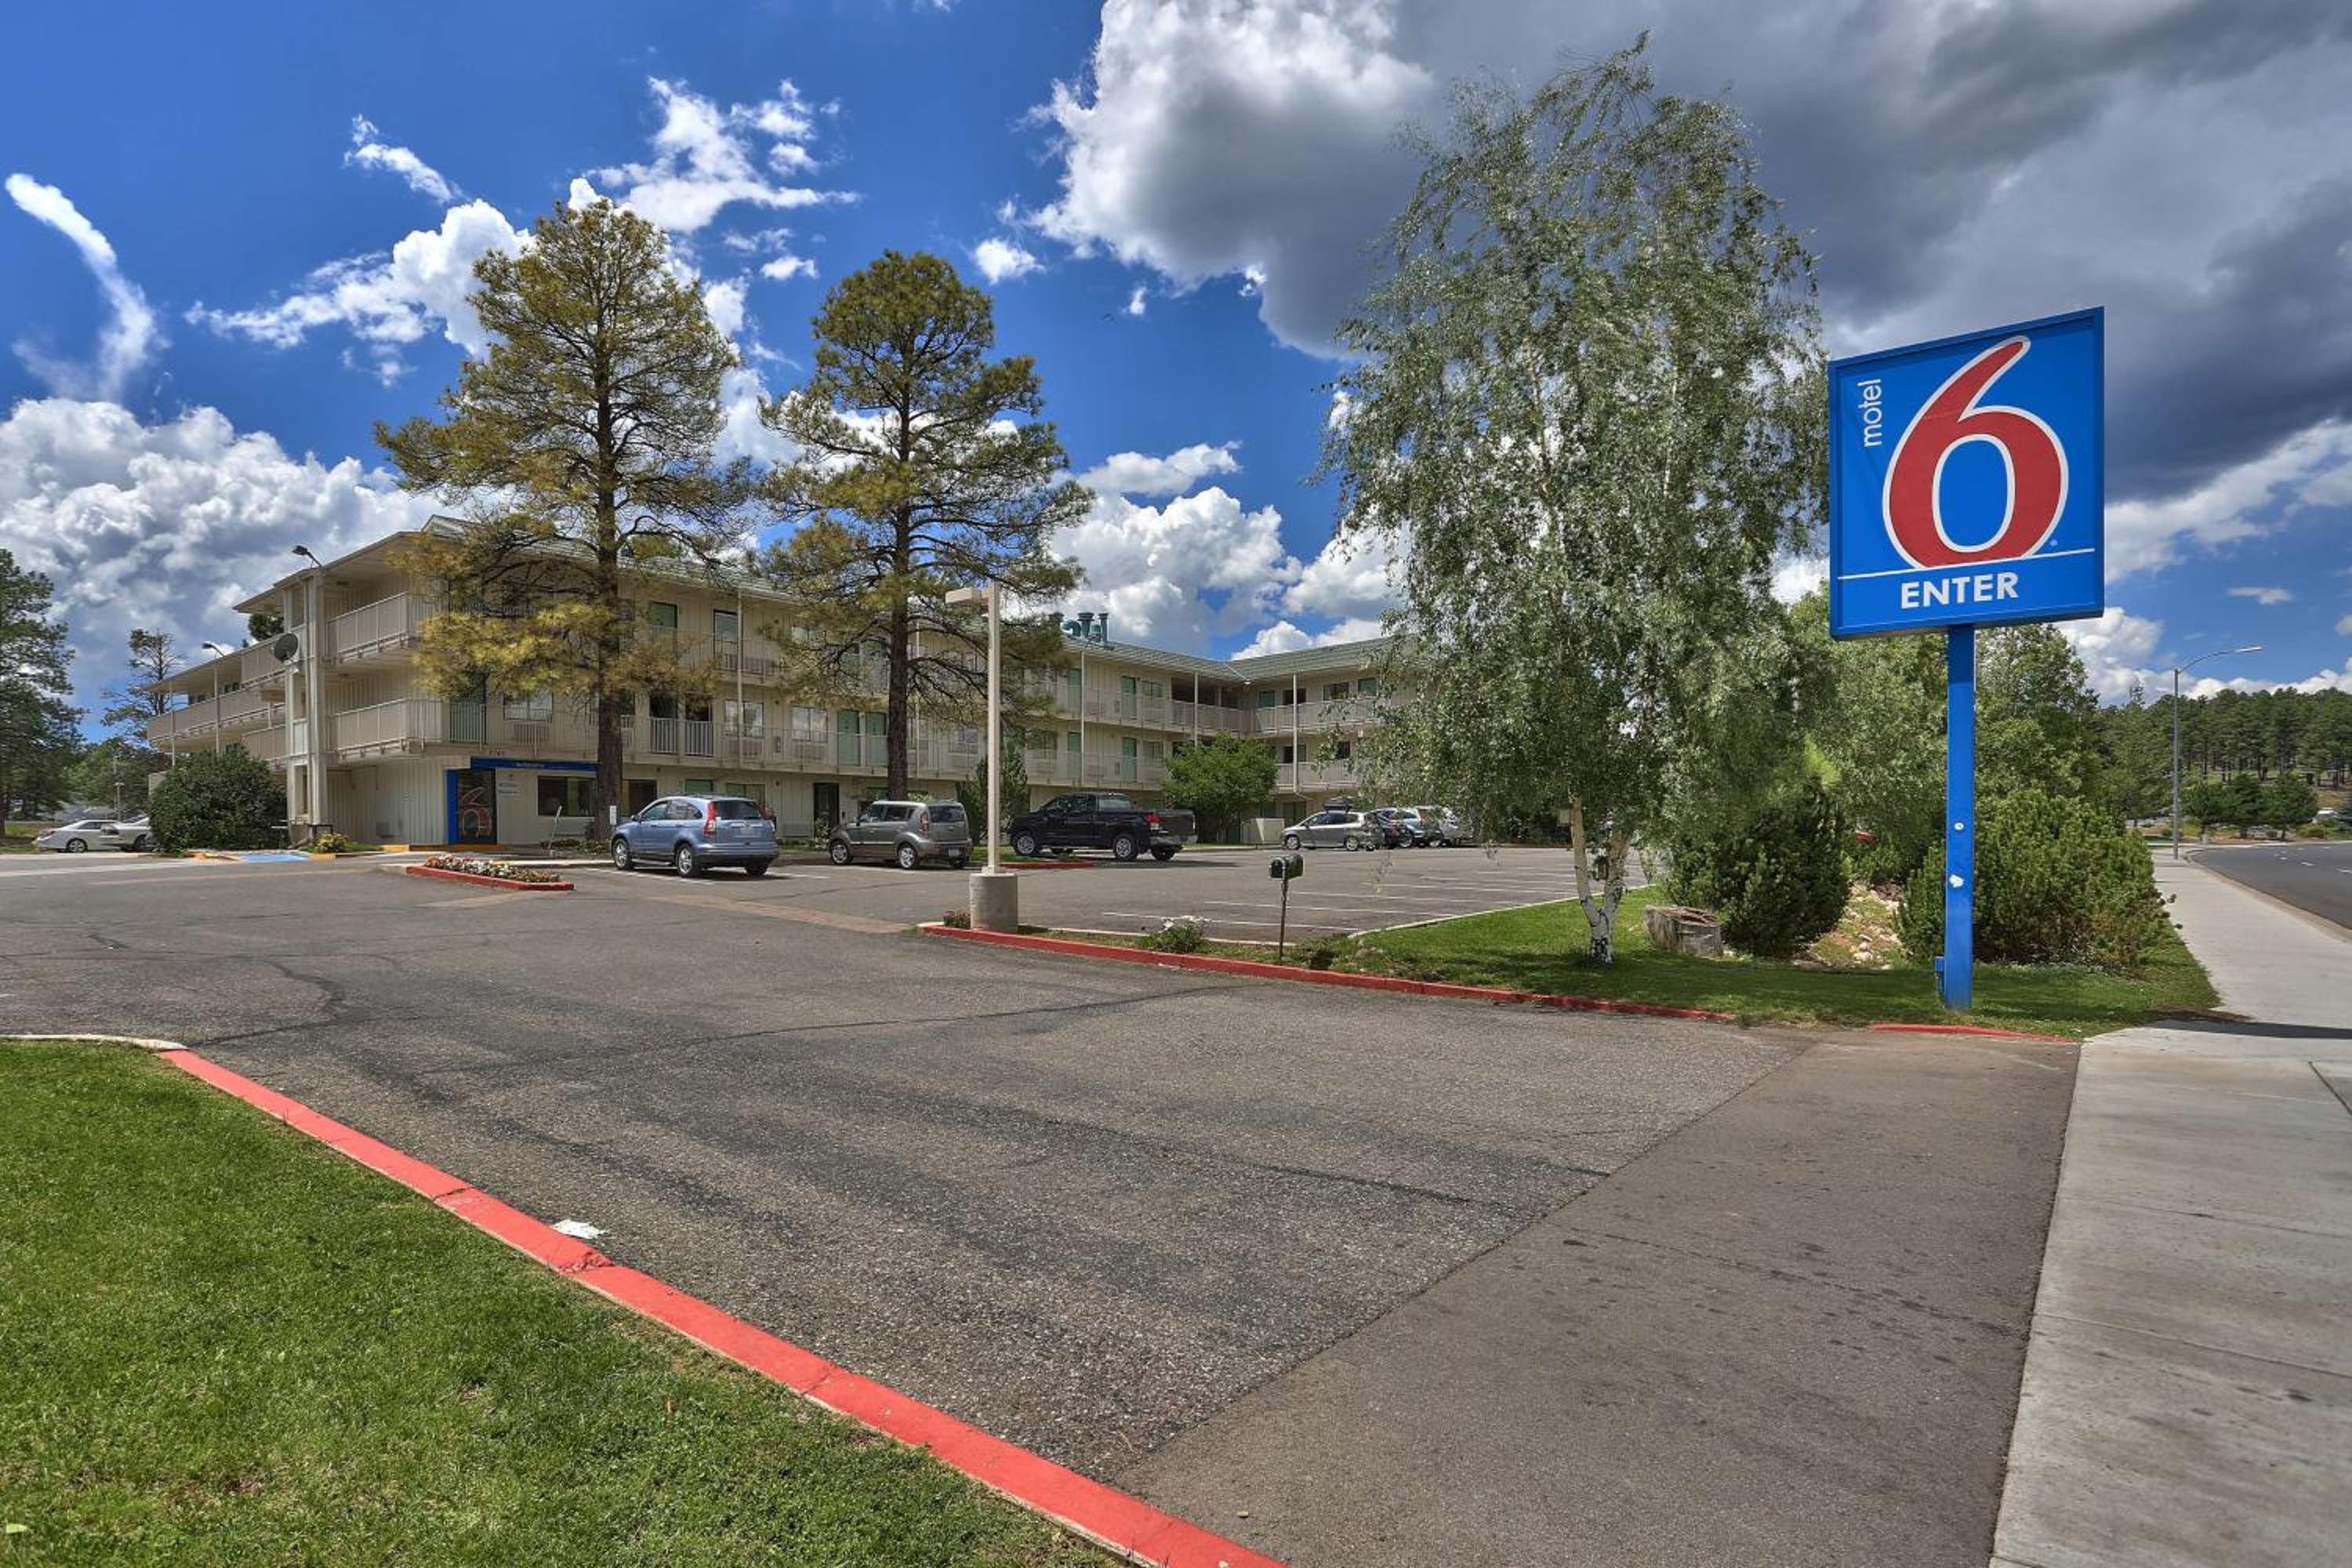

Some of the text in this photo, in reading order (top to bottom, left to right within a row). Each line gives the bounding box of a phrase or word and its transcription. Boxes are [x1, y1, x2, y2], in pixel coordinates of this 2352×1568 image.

[1857, 379, 1882, 448] motel
[1882, 335, 2070, 569] 6
[1900, 572, 2020, 610] ENTER
